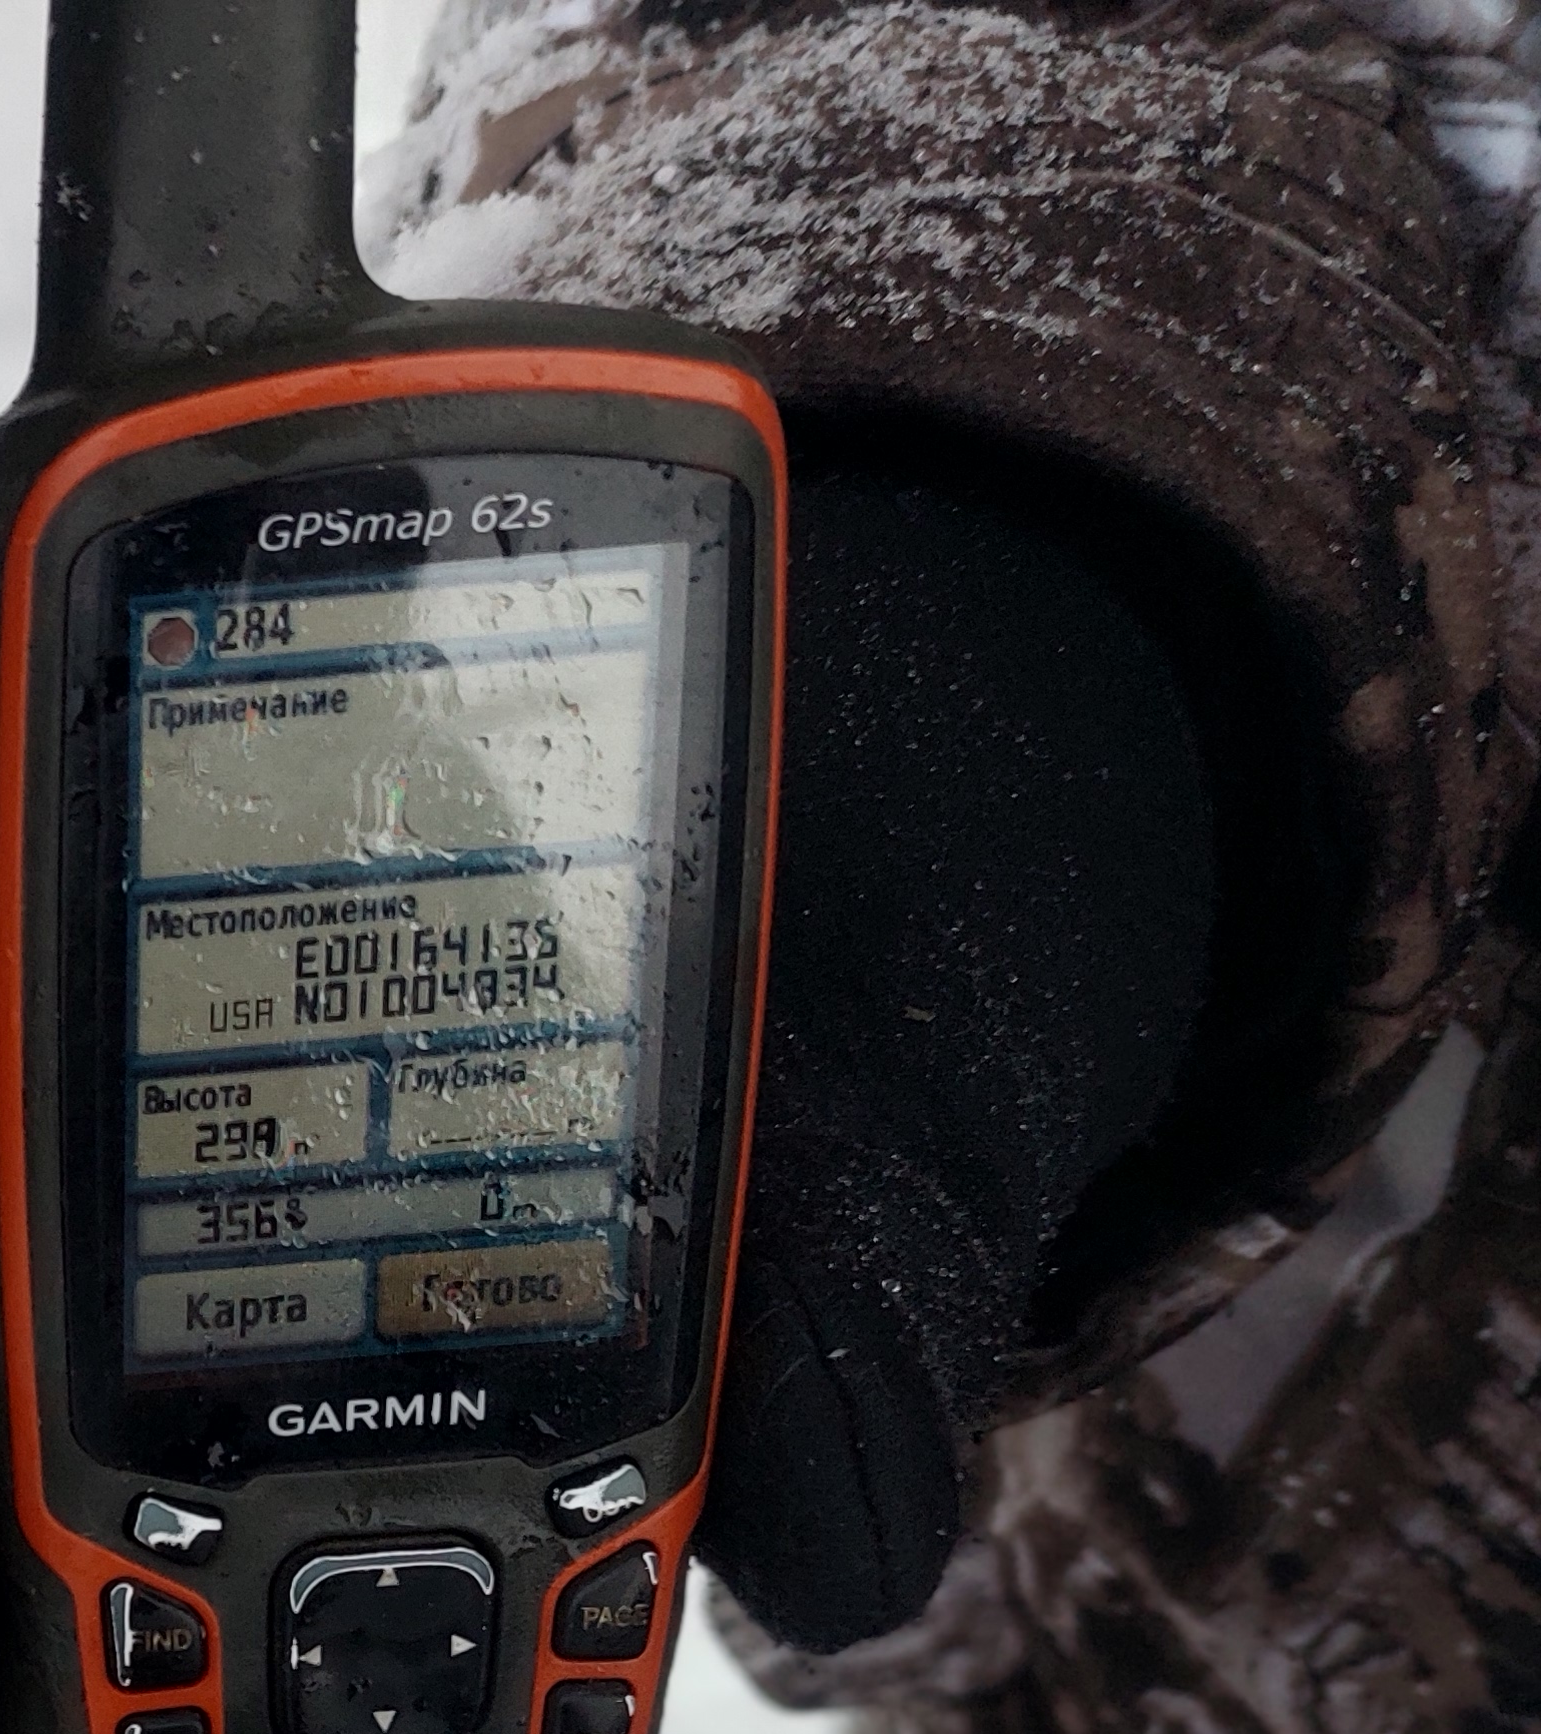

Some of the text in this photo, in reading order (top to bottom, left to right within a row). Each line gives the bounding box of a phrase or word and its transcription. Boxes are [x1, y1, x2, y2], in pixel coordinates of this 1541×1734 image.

[258, 493, 554, 552] GPSmap 62s
[216, 602, 295, 652] 284
[147, 685, 349, 736] Примечание
[145, 893, 418, 942] Местоположение
[209, 997, 274, 1034] USA
[143, 1083, 252, 1115] Высота
[185, 1291, 309, 1336] Карта
[267, 1388, 487, 1438] GARMIN
[580, 1602, 650, 1631] PAGE
[129, 1627, 193, 1654] FIND
